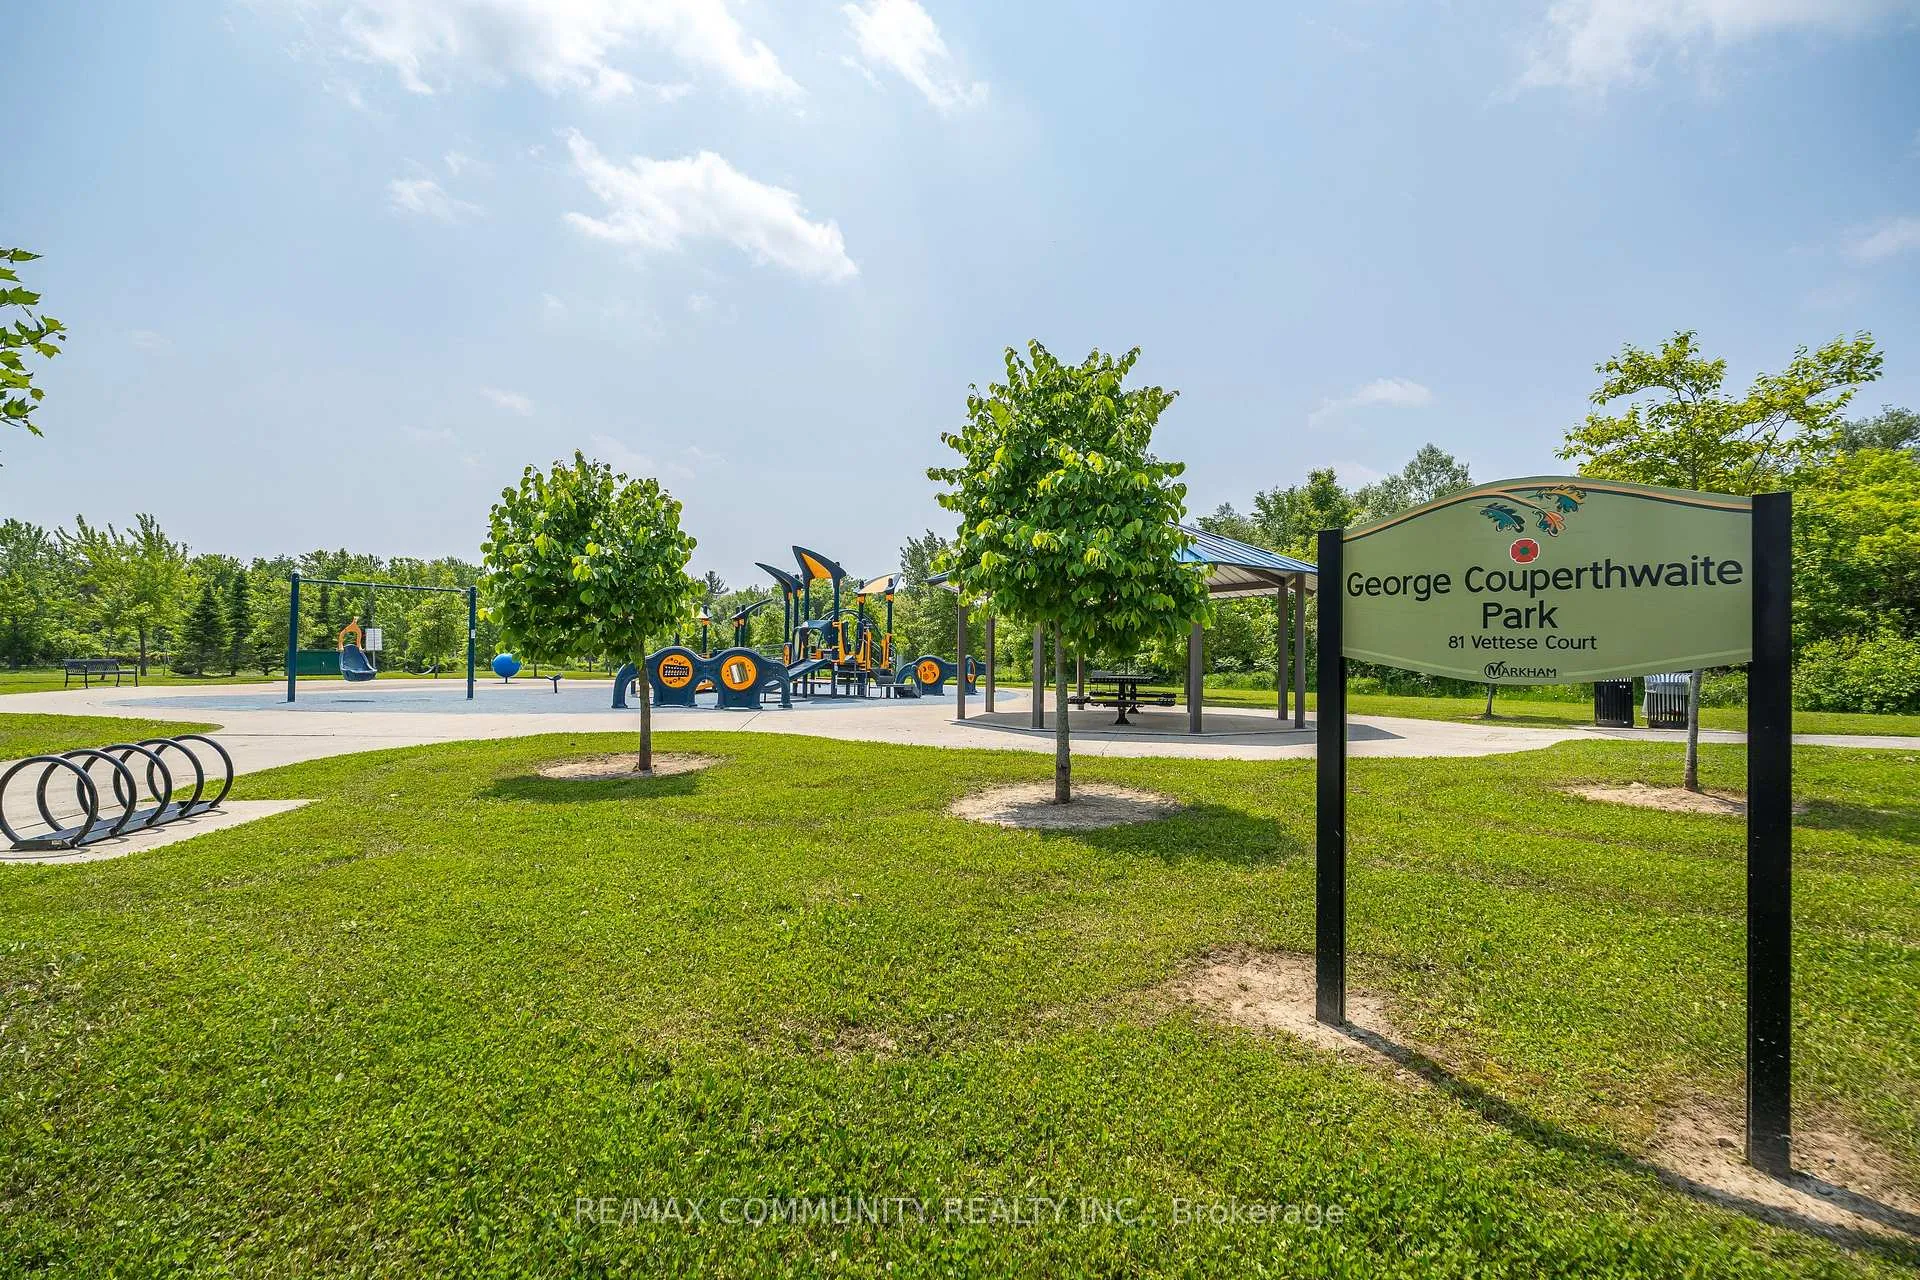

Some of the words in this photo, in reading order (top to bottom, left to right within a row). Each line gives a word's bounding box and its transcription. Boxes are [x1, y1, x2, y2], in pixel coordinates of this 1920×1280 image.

[1346, 571, 1452, 602] George
[1464, 554, 1744, 599] Couperthwaite
[1482, 600, 1559, 630] Park
[1448, 635, 1465, 649] 81
[1471, 635, 1538, 650] Vettese
[1545, 635, 1598, 650] Court
[1483, 660, 1558, 680] MARKHAM
